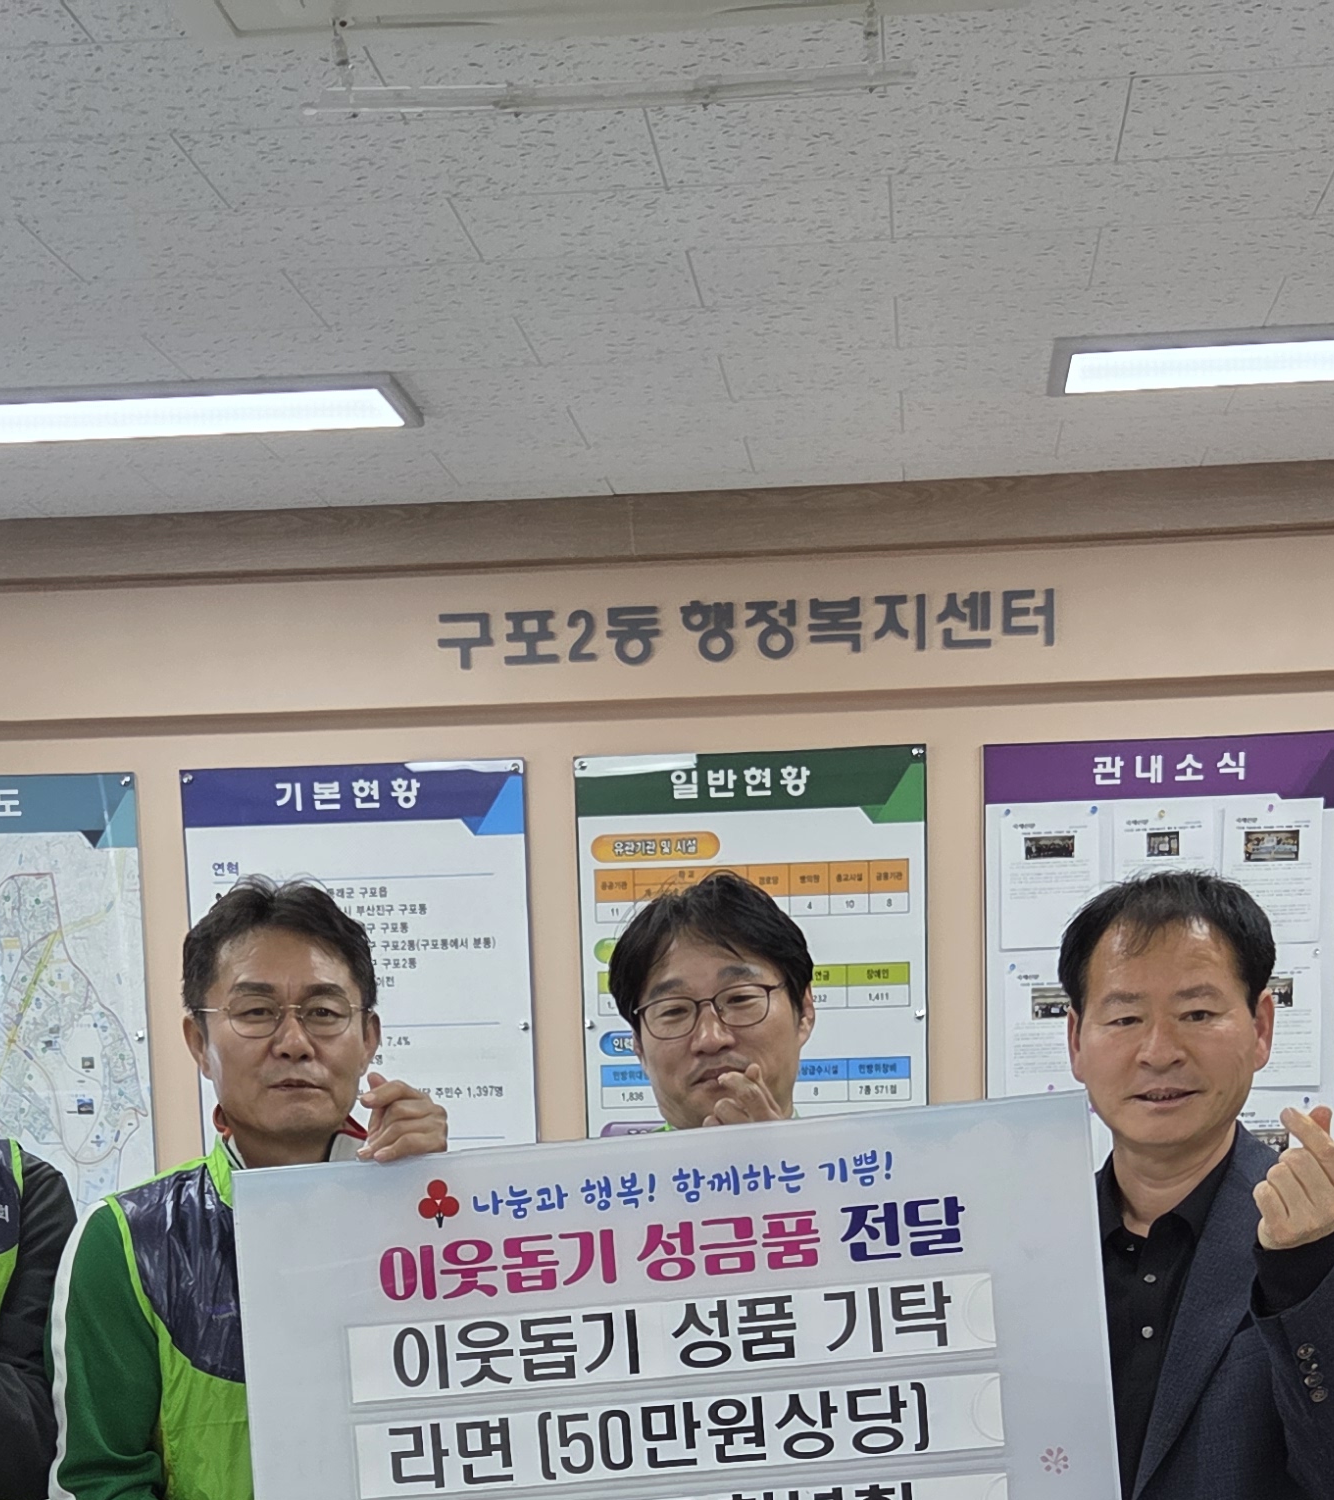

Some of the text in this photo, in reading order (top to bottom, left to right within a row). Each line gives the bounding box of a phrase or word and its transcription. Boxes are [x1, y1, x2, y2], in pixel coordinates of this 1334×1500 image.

[437, 587, 1057, 670] 구포2동 행정복지센터
[275, 778, 421, 812] 기본현황
[671, 766, 810, 800] 일반현황
[1093, 752, 1246, 785] 관내소식
[613, 840, 656, 856] 유관기관
[472, 1149, 894, 1221] 나눔과 행복! 함께하는 기쁨!
[379, 1195, 966, 1303] 이웃돕기 성금품 전달
[392, 1280, 953, 1392] 이웃돕기 성품 기탁
[388, 1417, 515, 1491] 라면
